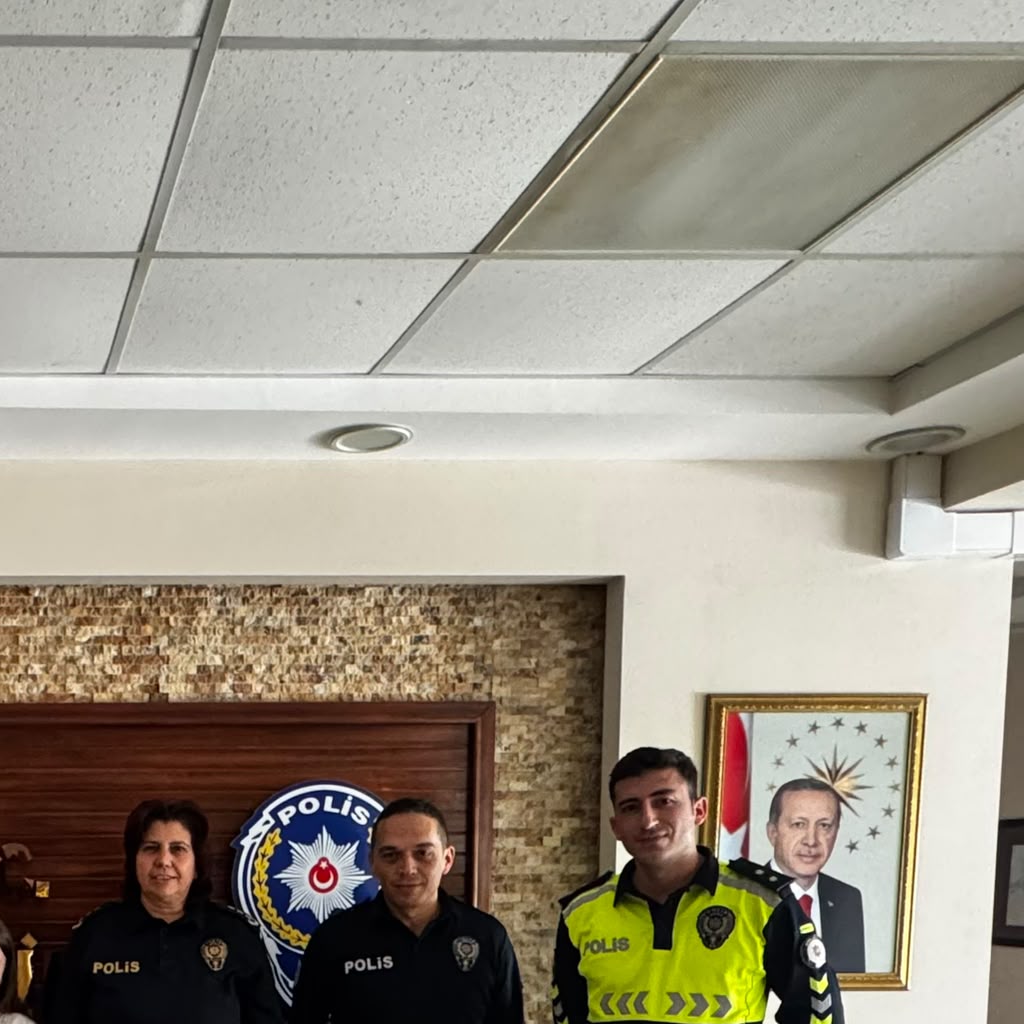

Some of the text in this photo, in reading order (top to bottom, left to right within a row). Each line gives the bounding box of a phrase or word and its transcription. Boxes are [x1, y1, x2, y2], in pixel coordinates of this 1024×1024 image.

[277, 795, 371, 826] POLİS
[92, 960, 141, 975] POLİS
[344, 955, 394, 975] POLİS
